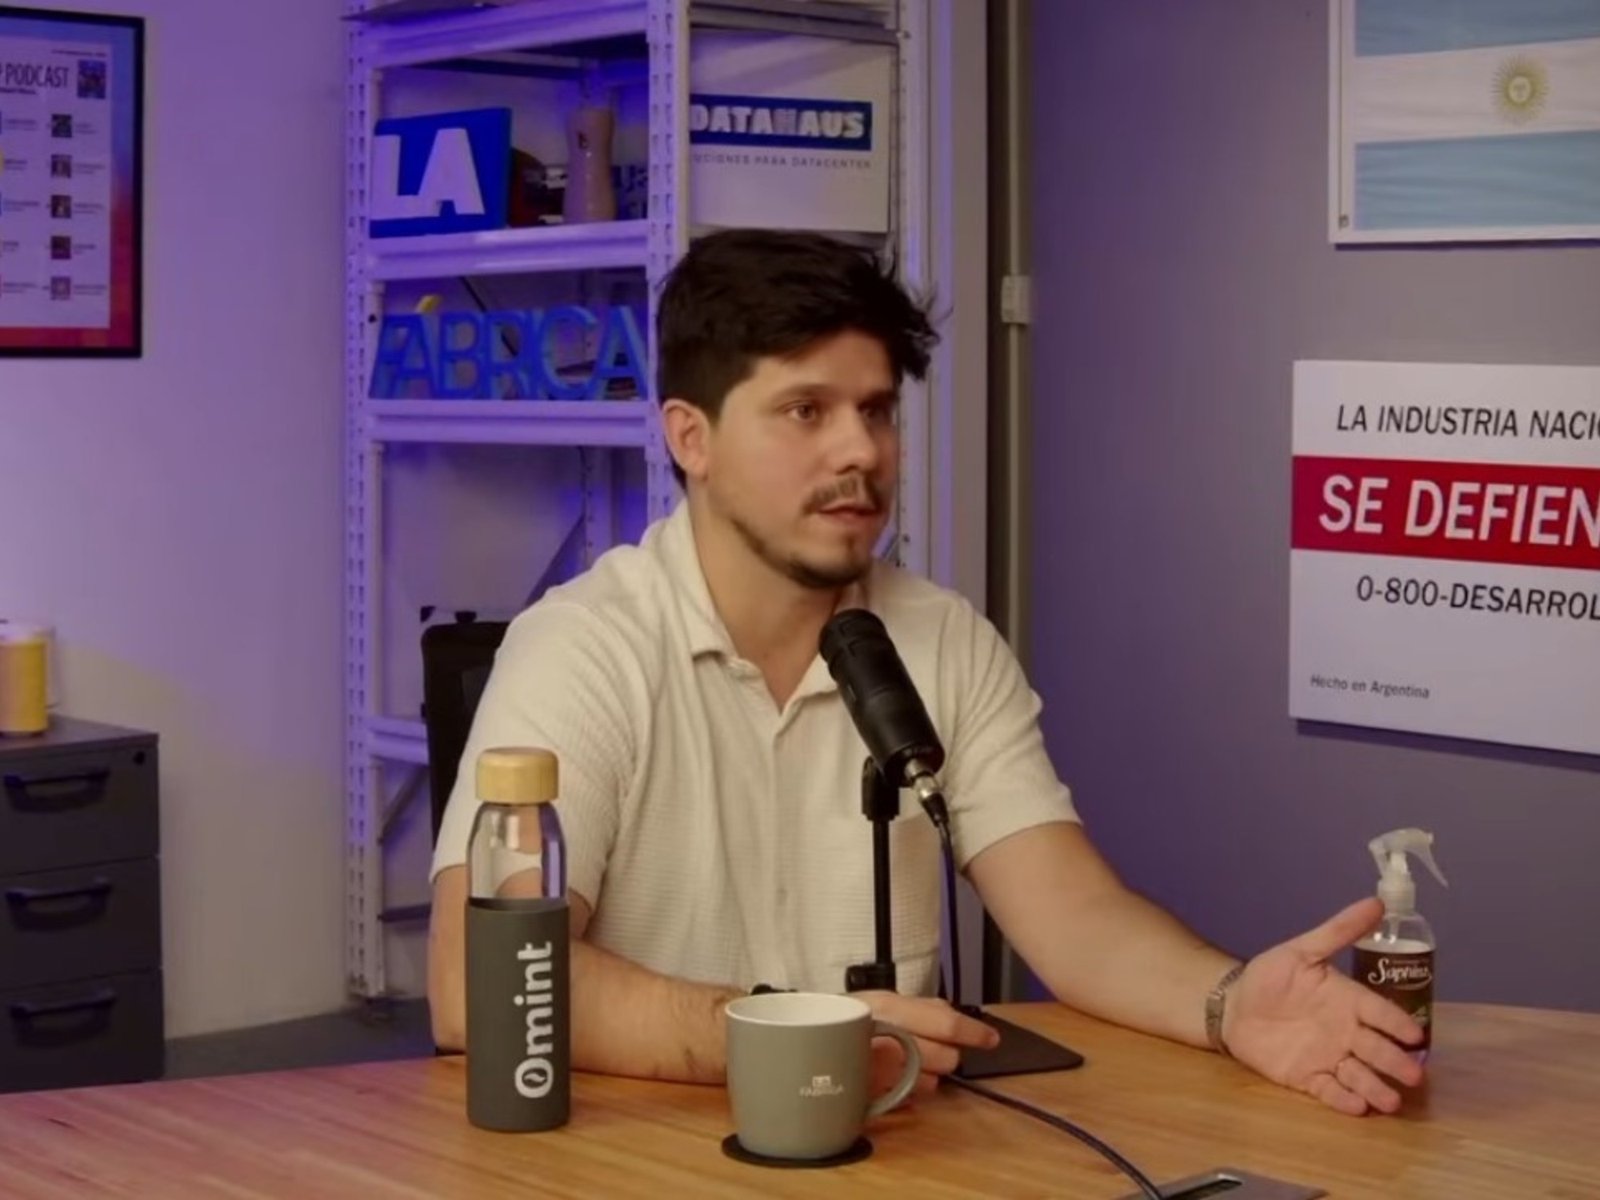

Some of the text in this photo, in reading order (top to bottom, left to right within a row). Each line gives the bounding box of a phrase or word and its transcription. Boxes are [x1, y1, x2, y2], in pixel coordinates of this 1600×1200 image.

[5, 61, 69, 88] PODCAST
[690, 103, 865, 139] DATAHAUS
[370, 128, 485, 220] LA
[754, 155, 787, 166] PARA
[1337, 404, 1600, 440] LA INDUSTRIA NACI
[1318, 474, 1600, 549] SE DEFIEN
[1310, 675, 1430, 699] Hecho en Argentina
[513, 940, 554, 1098] Omint
